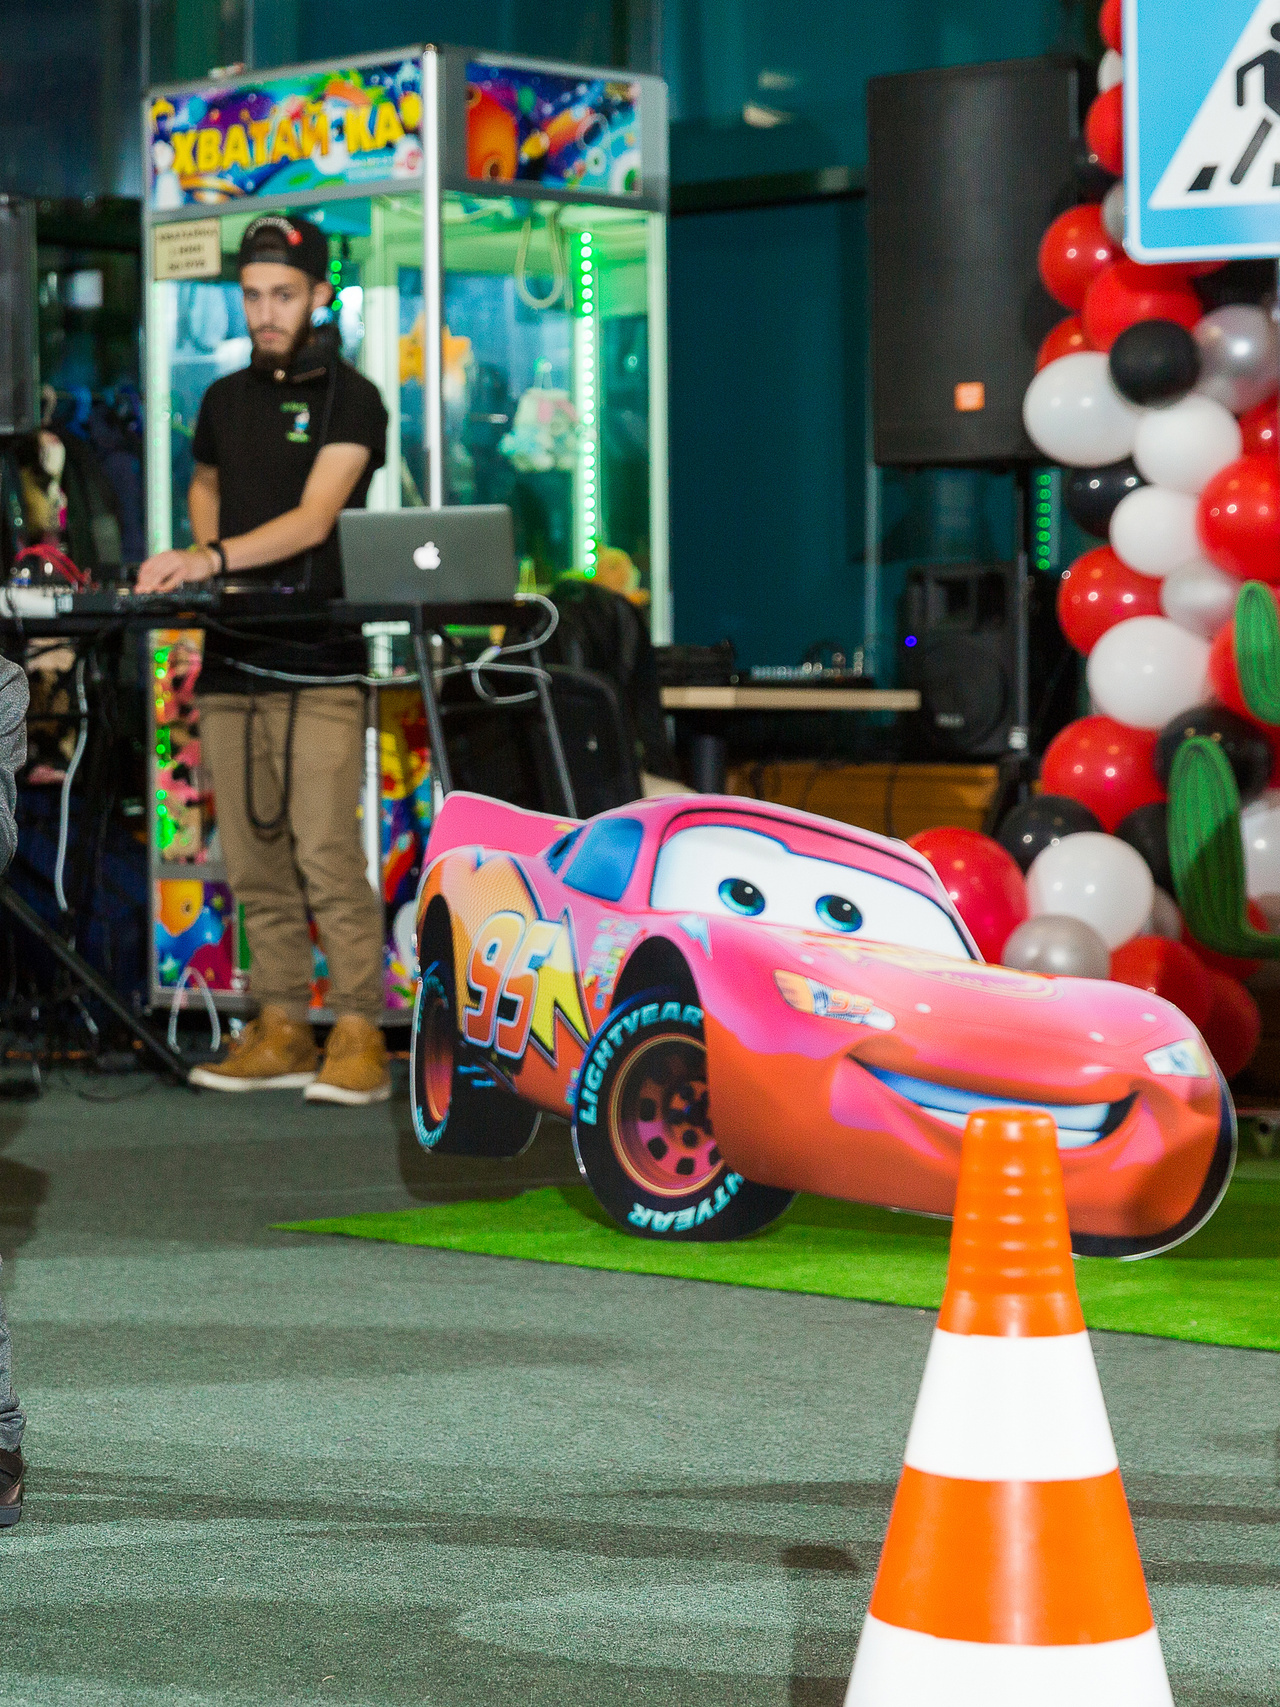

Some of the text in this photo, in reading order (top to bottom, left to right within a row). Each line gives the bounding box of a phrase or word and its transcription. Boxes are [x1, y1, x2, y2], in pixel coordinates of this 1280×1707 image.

[462, 909, 562, 1061] 95
[826, 989, 875, 1015] 95
[578, 1001, 705, 1126] LIGHTYEAR
